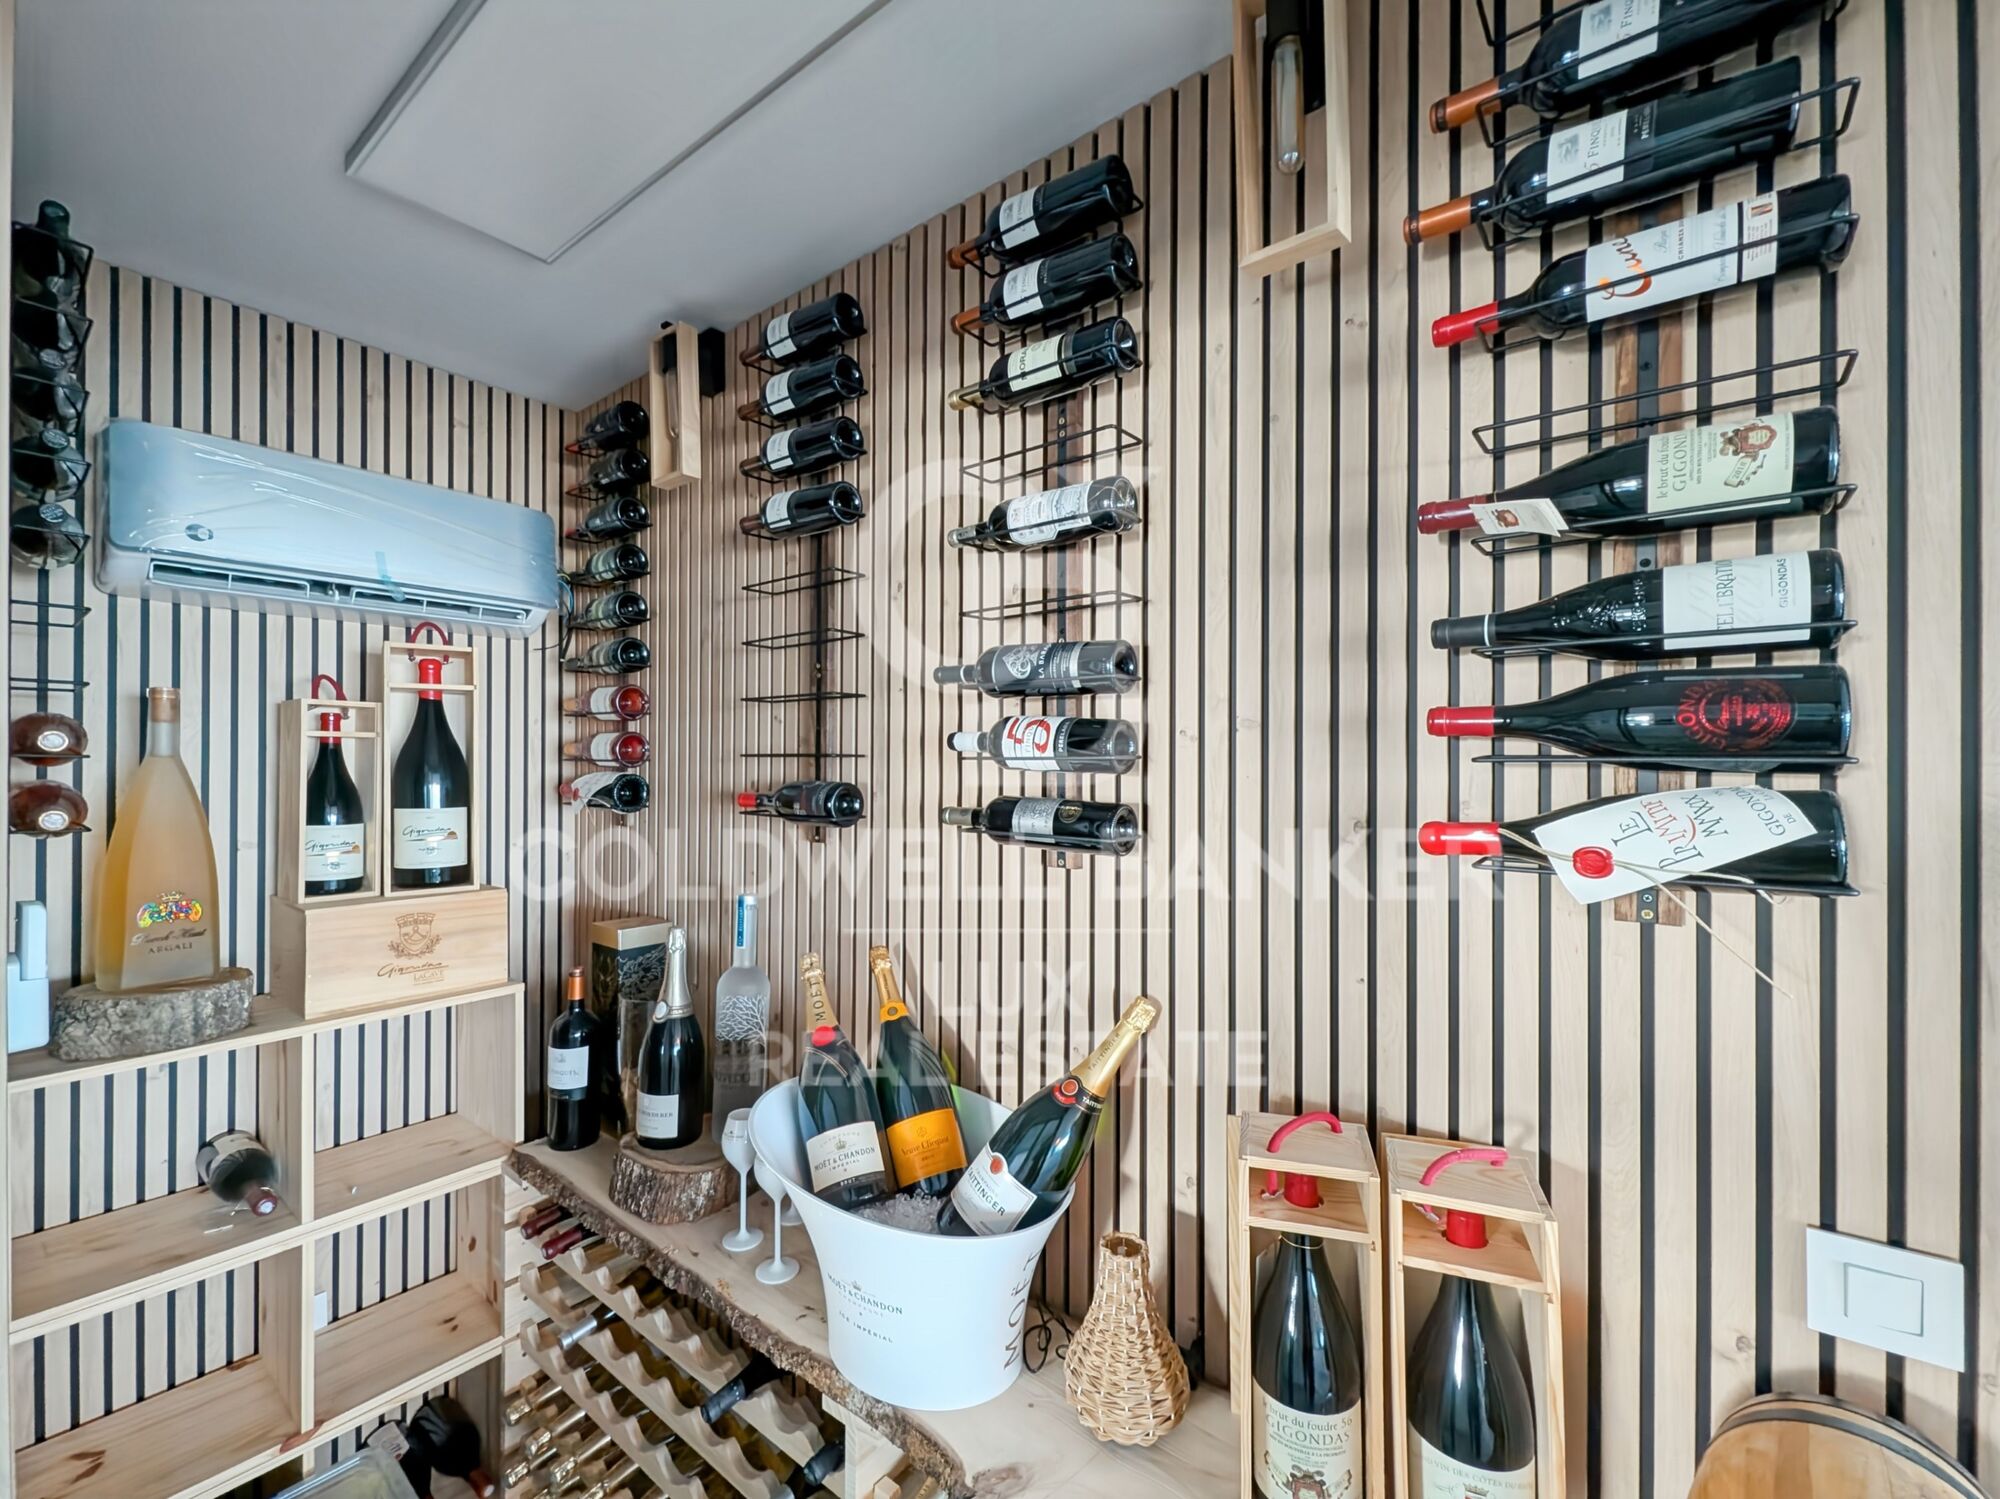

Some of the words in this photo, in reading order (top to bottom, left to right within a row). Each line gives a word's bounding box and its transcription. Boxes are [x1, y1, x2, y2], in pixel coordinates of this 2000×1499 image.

[1777, 557, 1789, 608] GIGONDAS
[838, 1147, 876, 1161] CHANDON
[854, 1291, 903, 1315] CHANDON
